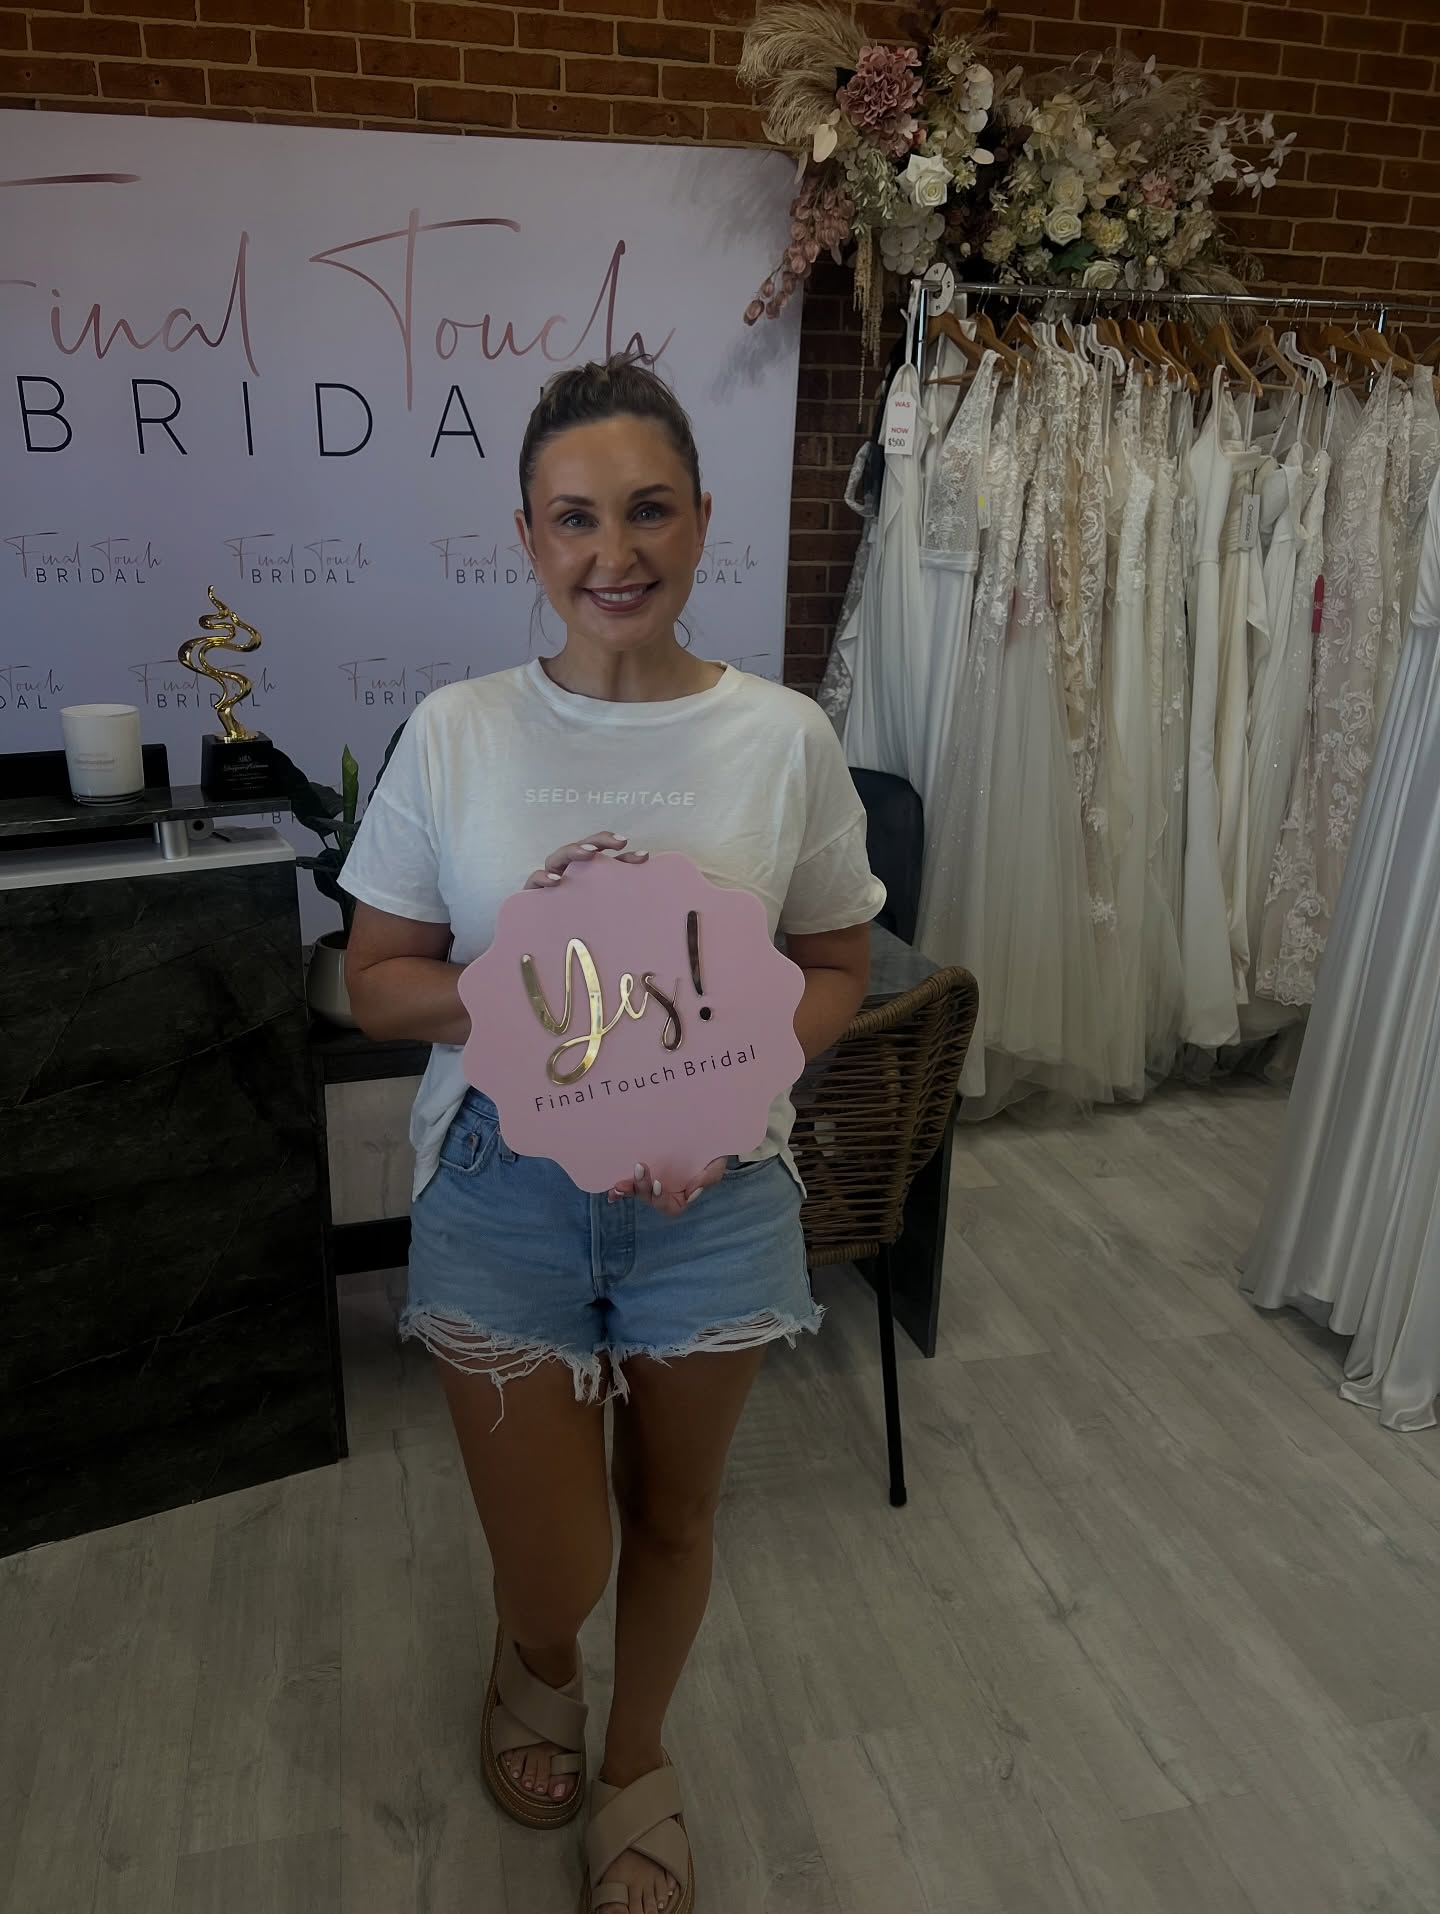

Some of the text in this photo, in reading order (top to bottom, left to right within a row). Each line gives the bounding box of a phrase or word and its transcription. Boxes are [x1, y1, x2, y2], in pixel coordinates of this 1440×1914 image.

[309, 208, 677, 413] Touch
[17, 375, 543, 457] BRIDA
[4, 532, 162, 578] Final Touch
[36, 568, 146, 583] BRIDAL
[224, 534, 371, 579] Final Touch
[251, 569, 355, 583] BRIDAL
[430, 535, 497, 580] Final
[456, 569, 536, 584] BRIDA
[0, 665, 64, 701] Touch
[128, 660, 200, 704] Final
[338, 658, 406, 703] Final
[525, 788, 696, 807] SEED HERITAGE
[521, 910, 714, 1085] Yes!
[535, 1044, 756, 1112] Final Touch Bridal
